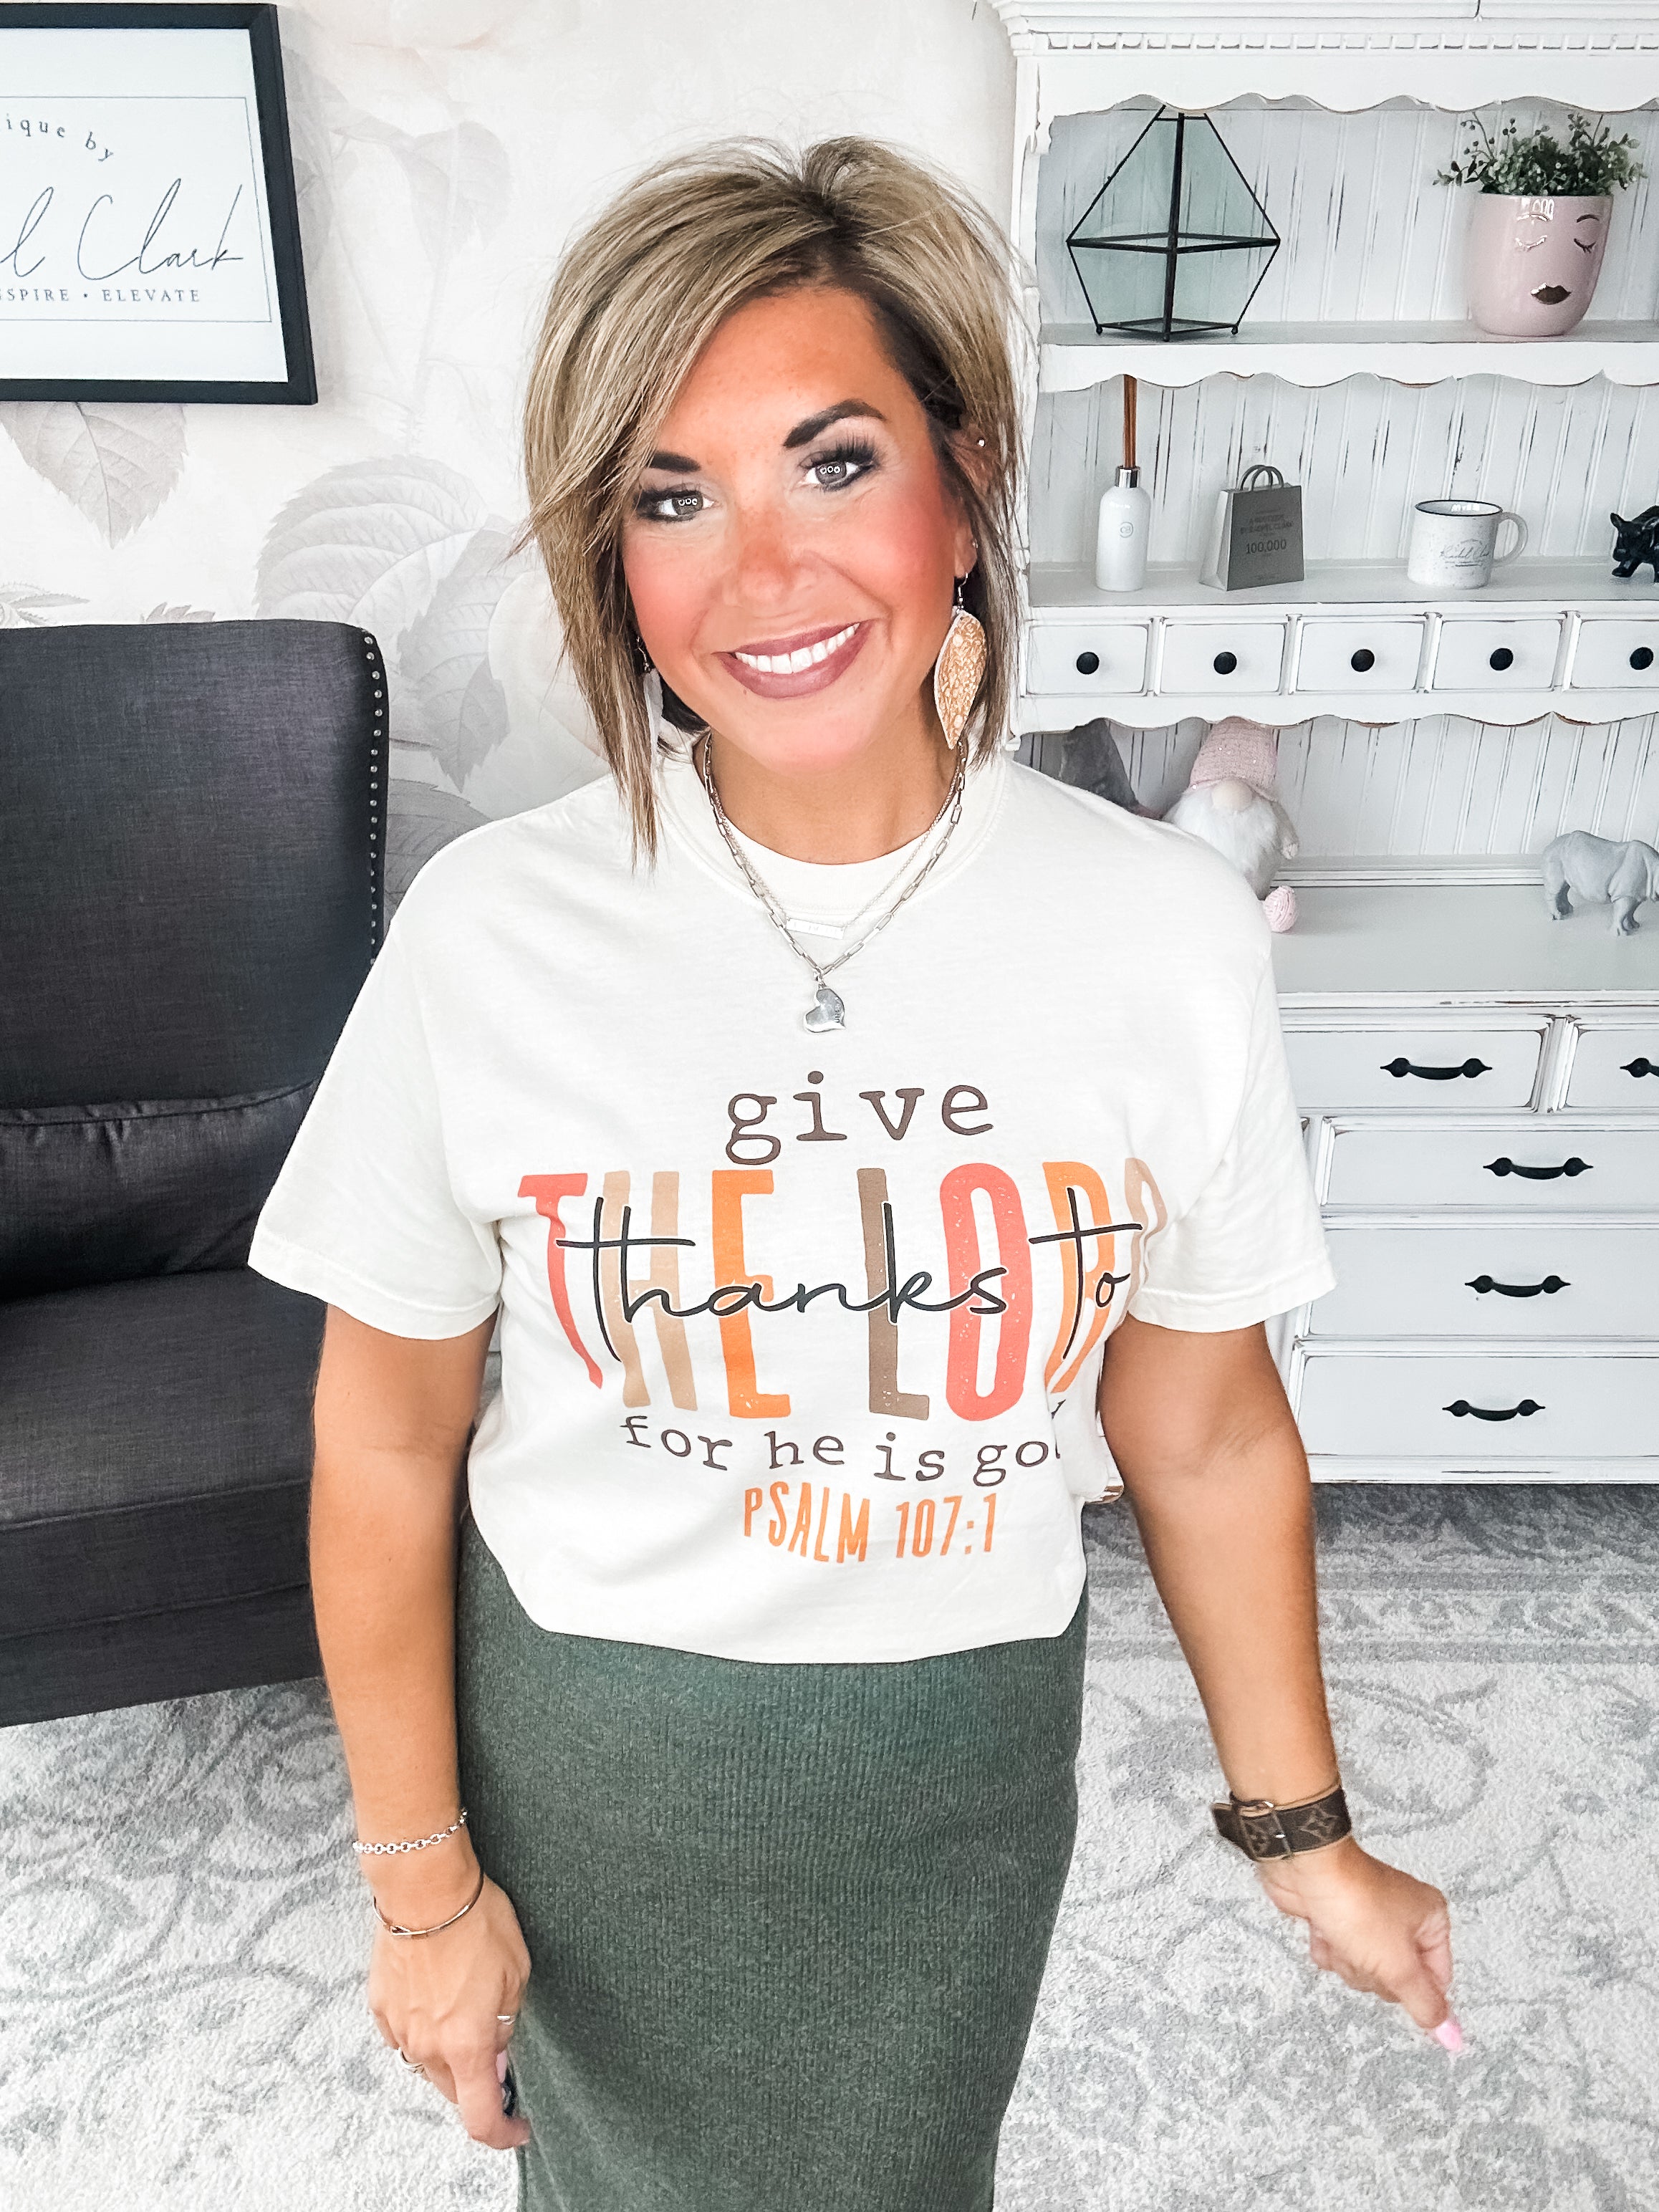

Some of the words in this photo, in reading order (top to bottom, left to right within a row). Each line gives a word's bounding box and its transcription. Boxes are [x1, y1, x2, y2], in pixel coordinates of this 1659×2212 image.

[84, 130, 115, 163] by
[77, 178, 244, 281] Clark
[0, 288, 70, 302] SPIRE
[102, 289, 201, 303] ELEVATE
[725, 1070, 994, 1165] give
[517, 1168, 792, 1419] THE
[555, 1196, 1009, 1363] thanks
[1029, 1186, 1143, 1360] to
[619, 1415, 734, 1472] for
[764, 1430, 845, 1470] he
[873, 1432, 946, 1482] is
[743, 1481, 871, 1564] PSALM
[895, 1492, 998, 1558] 107:1
